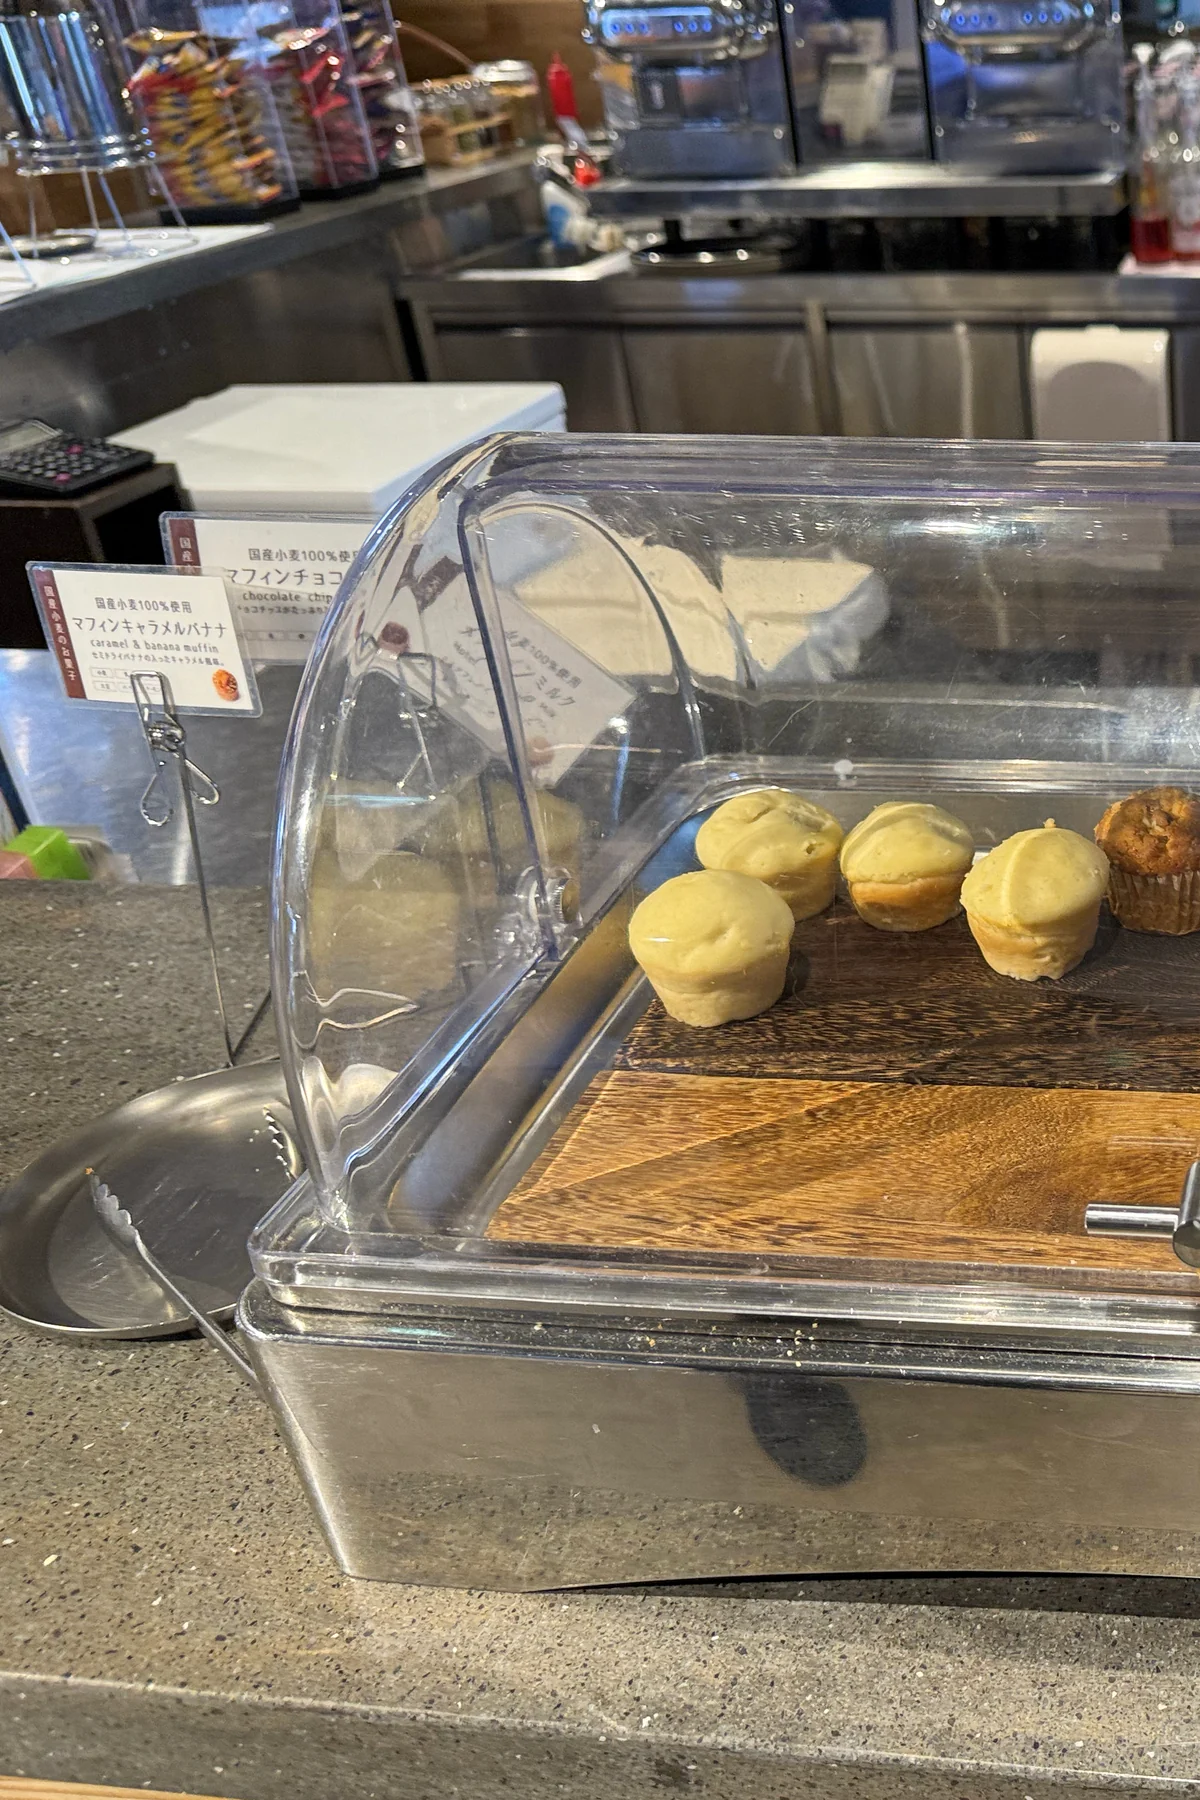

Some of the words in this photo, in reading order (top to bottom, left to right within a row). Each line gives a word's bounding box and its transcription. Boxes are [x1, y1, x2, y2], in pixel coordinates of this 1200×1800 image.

[242, 591, 301, 602] chocolate
[95, 597, 193, 614] 国産小麦100%使用
[72, 617, 227, 638] マフィンキャラメルバナナ
[90, 639, 129, 649] caramel
[133, 640, 141, 650] &
[144, 641, 181, 652] banana
[183, 643, 219, 654] muffin
